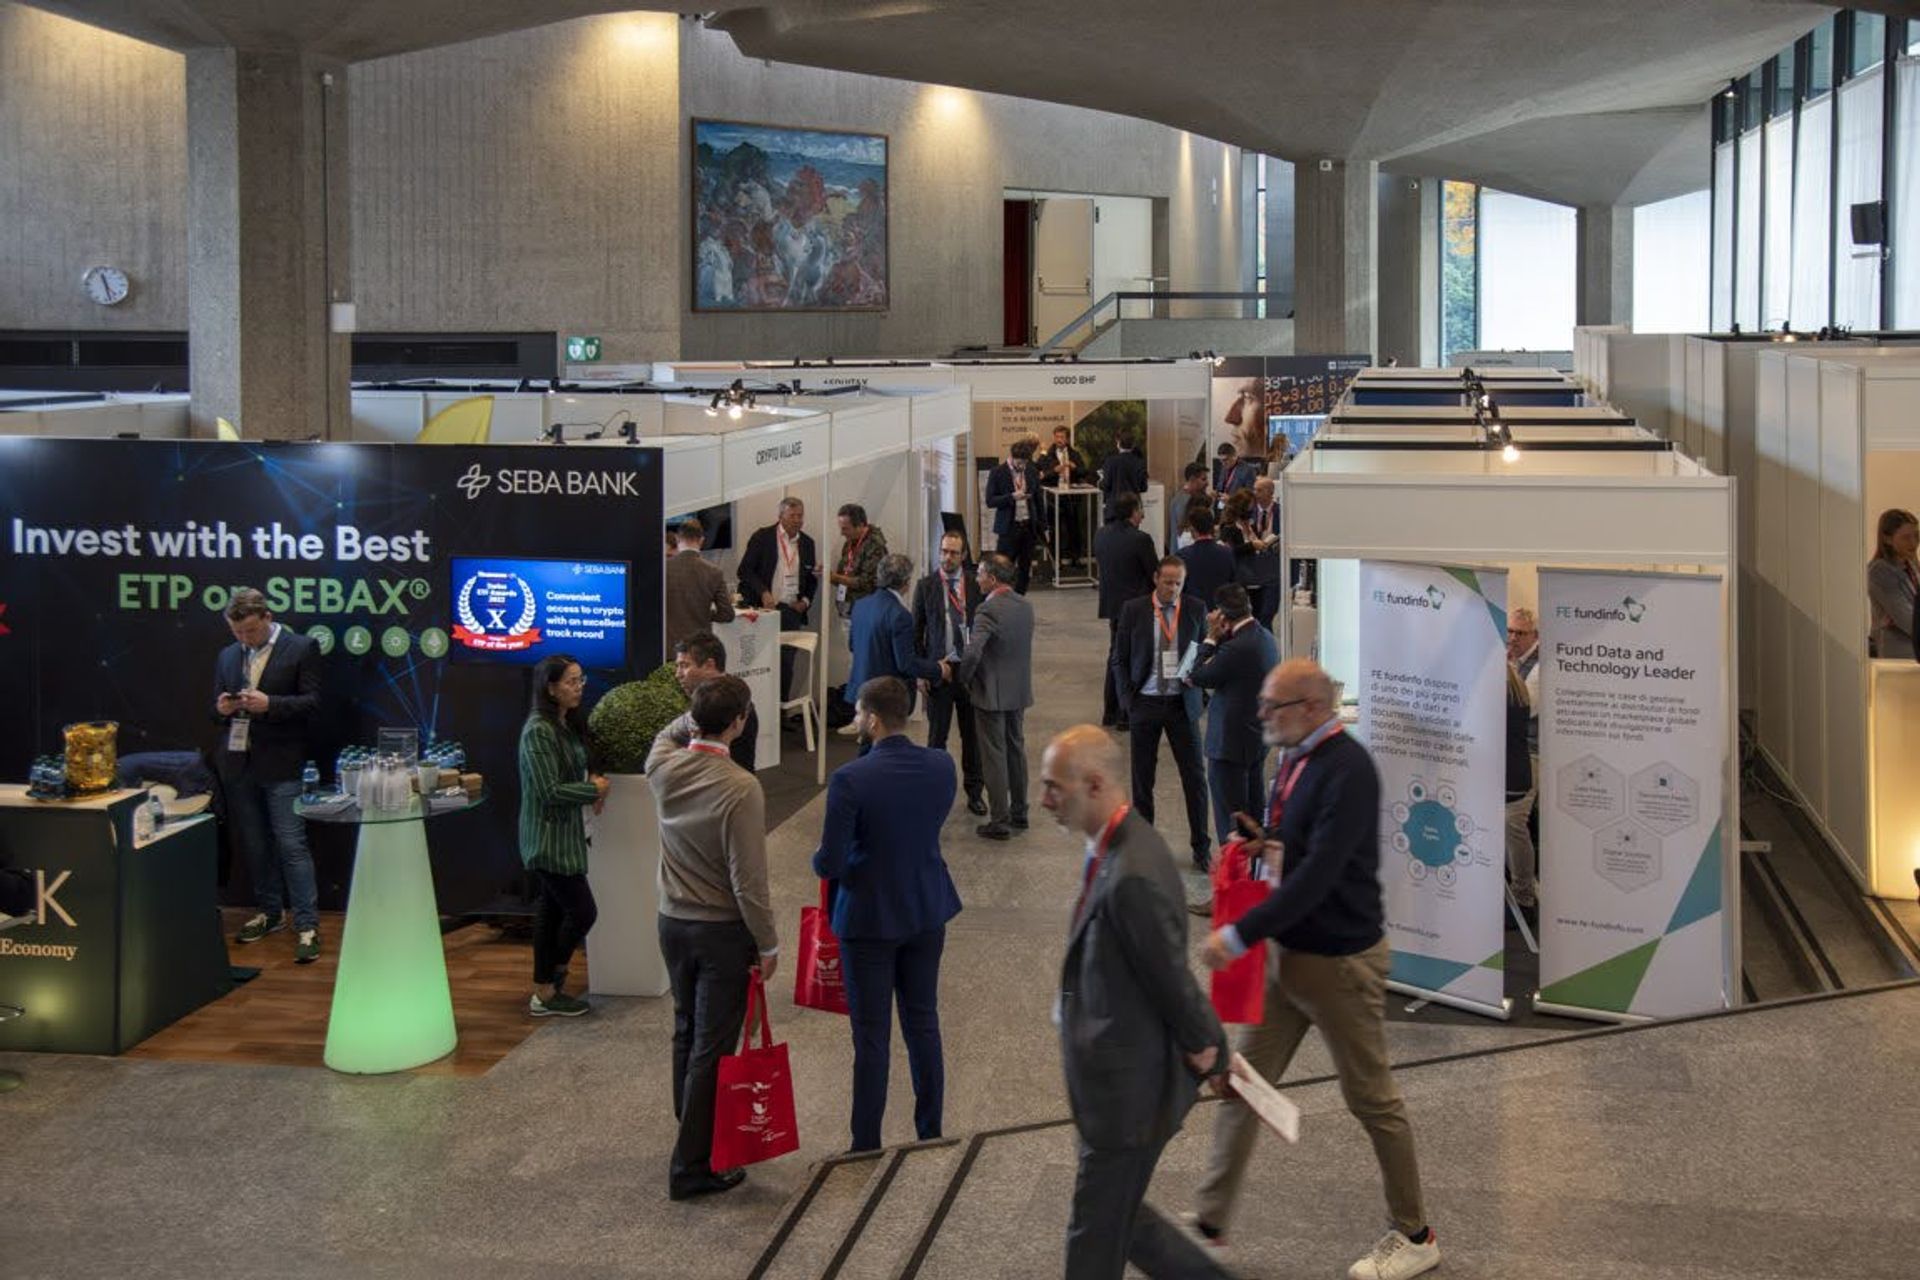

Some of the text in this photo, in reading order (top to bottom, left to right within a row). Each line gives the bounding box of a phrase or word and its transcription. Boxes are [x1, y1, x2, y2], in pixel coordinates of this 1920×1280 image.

[1079, 375, 1097, 385] BHF
[756, 446, 779, 465] CRYPTO
[497, 469, 640, 496] SEBA BANK
[13, 518, 430, 562] Invest with the Best
[583, 565, 605, 574] SEBA
[119, 573, 193, 610] ETP
[546, 591, 601, 602] Convenient
[1387, 591, 1429, 608] fundinfo
[546, 605, 624, 616] access to crypto
[1556, 605, 1626, 621] FE fundinfo
[546, 616, 569, 626] with
[582, 618, 627, 628] excellent
[546, 628, 604, 639] track record
[1556, 643, 1665, 662] Fund Data and
[1556, 658, 1696, 680] Technology Leader
[0, 938, 78, 961] Economy
